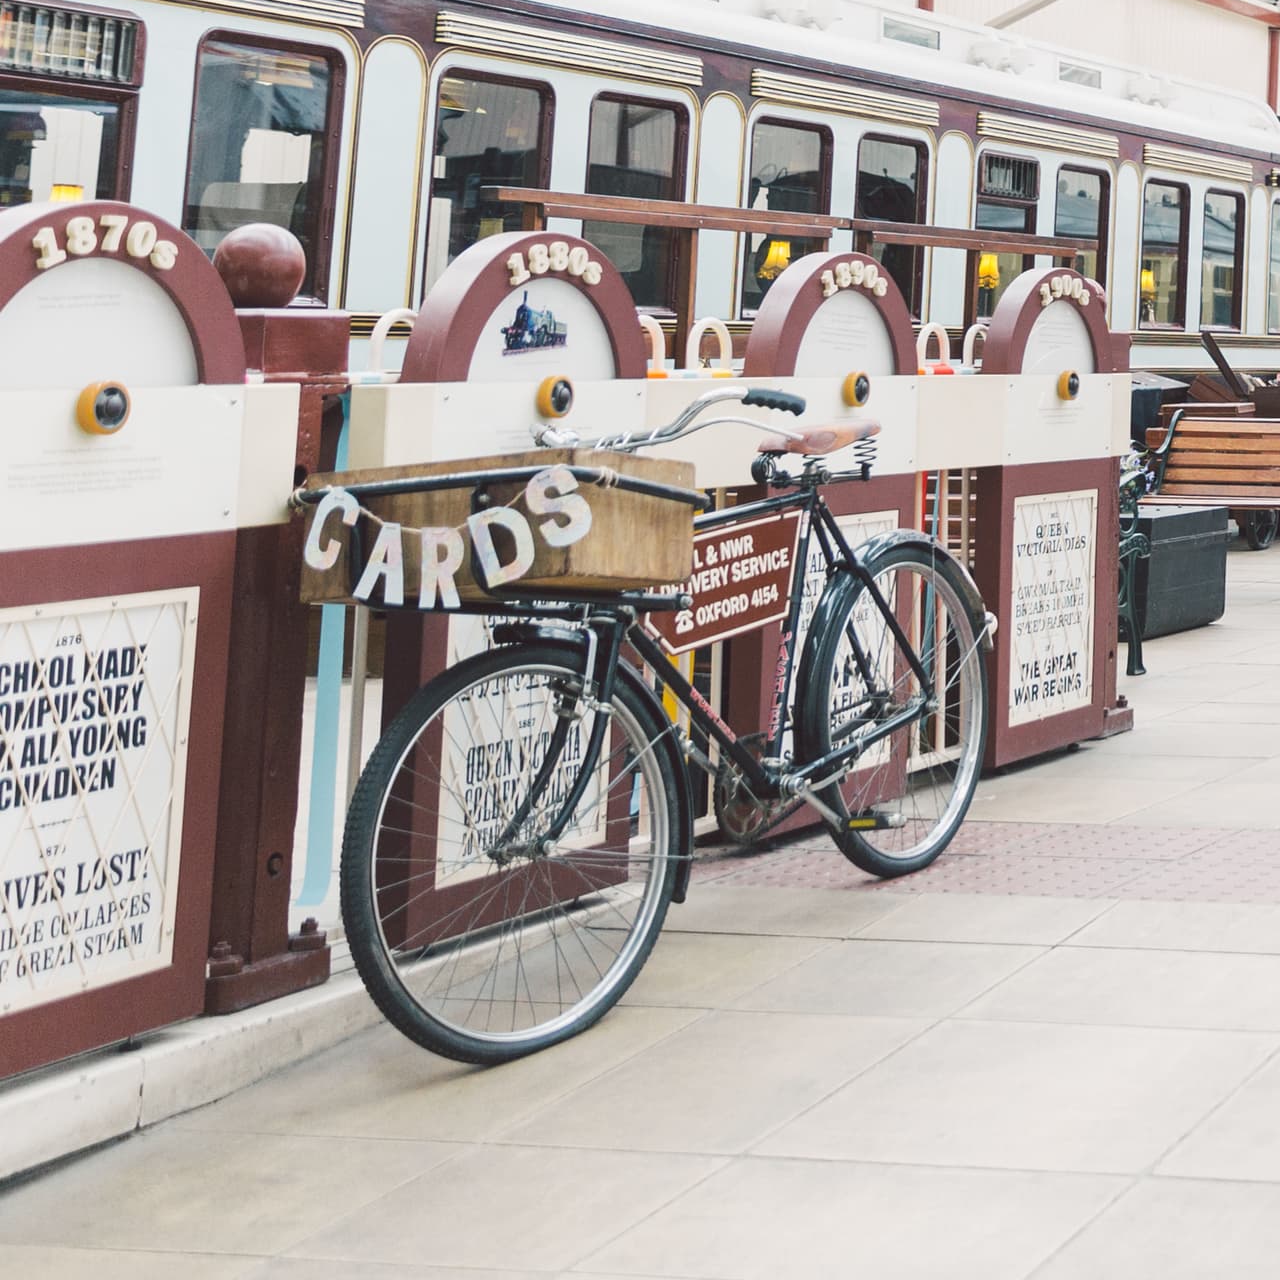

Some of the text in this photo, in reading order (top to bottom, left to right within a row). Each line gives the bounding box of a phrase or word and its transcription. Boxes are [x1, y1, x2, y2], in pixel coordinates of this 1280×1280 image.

[32, 214, 179, 270] 1870s
[506, 241, 603, 286] 1880s
[820, 260, 888, 298] 1890s
[1039, 275, 1091, 307] 1900s
[303, 465, 593, 609] CARDS
[705, 544, 718, 566] &
[719, 534, 754, 561] NWR
[731, 547, 790, 583] SERVICE
[695, 593, 750, 627] OXFORD
[751, 583, 779, 609] 4154
[55, 633, 83, 647] 1876
[0, 654, 76, 697] CHOOL
[1014, 683, 1039, 707] WAR
[0, 680, 145, 733] OMPULSORY
[68, 716, 148, 760] YOUNG
[0, 867, 67, 915] IVES
